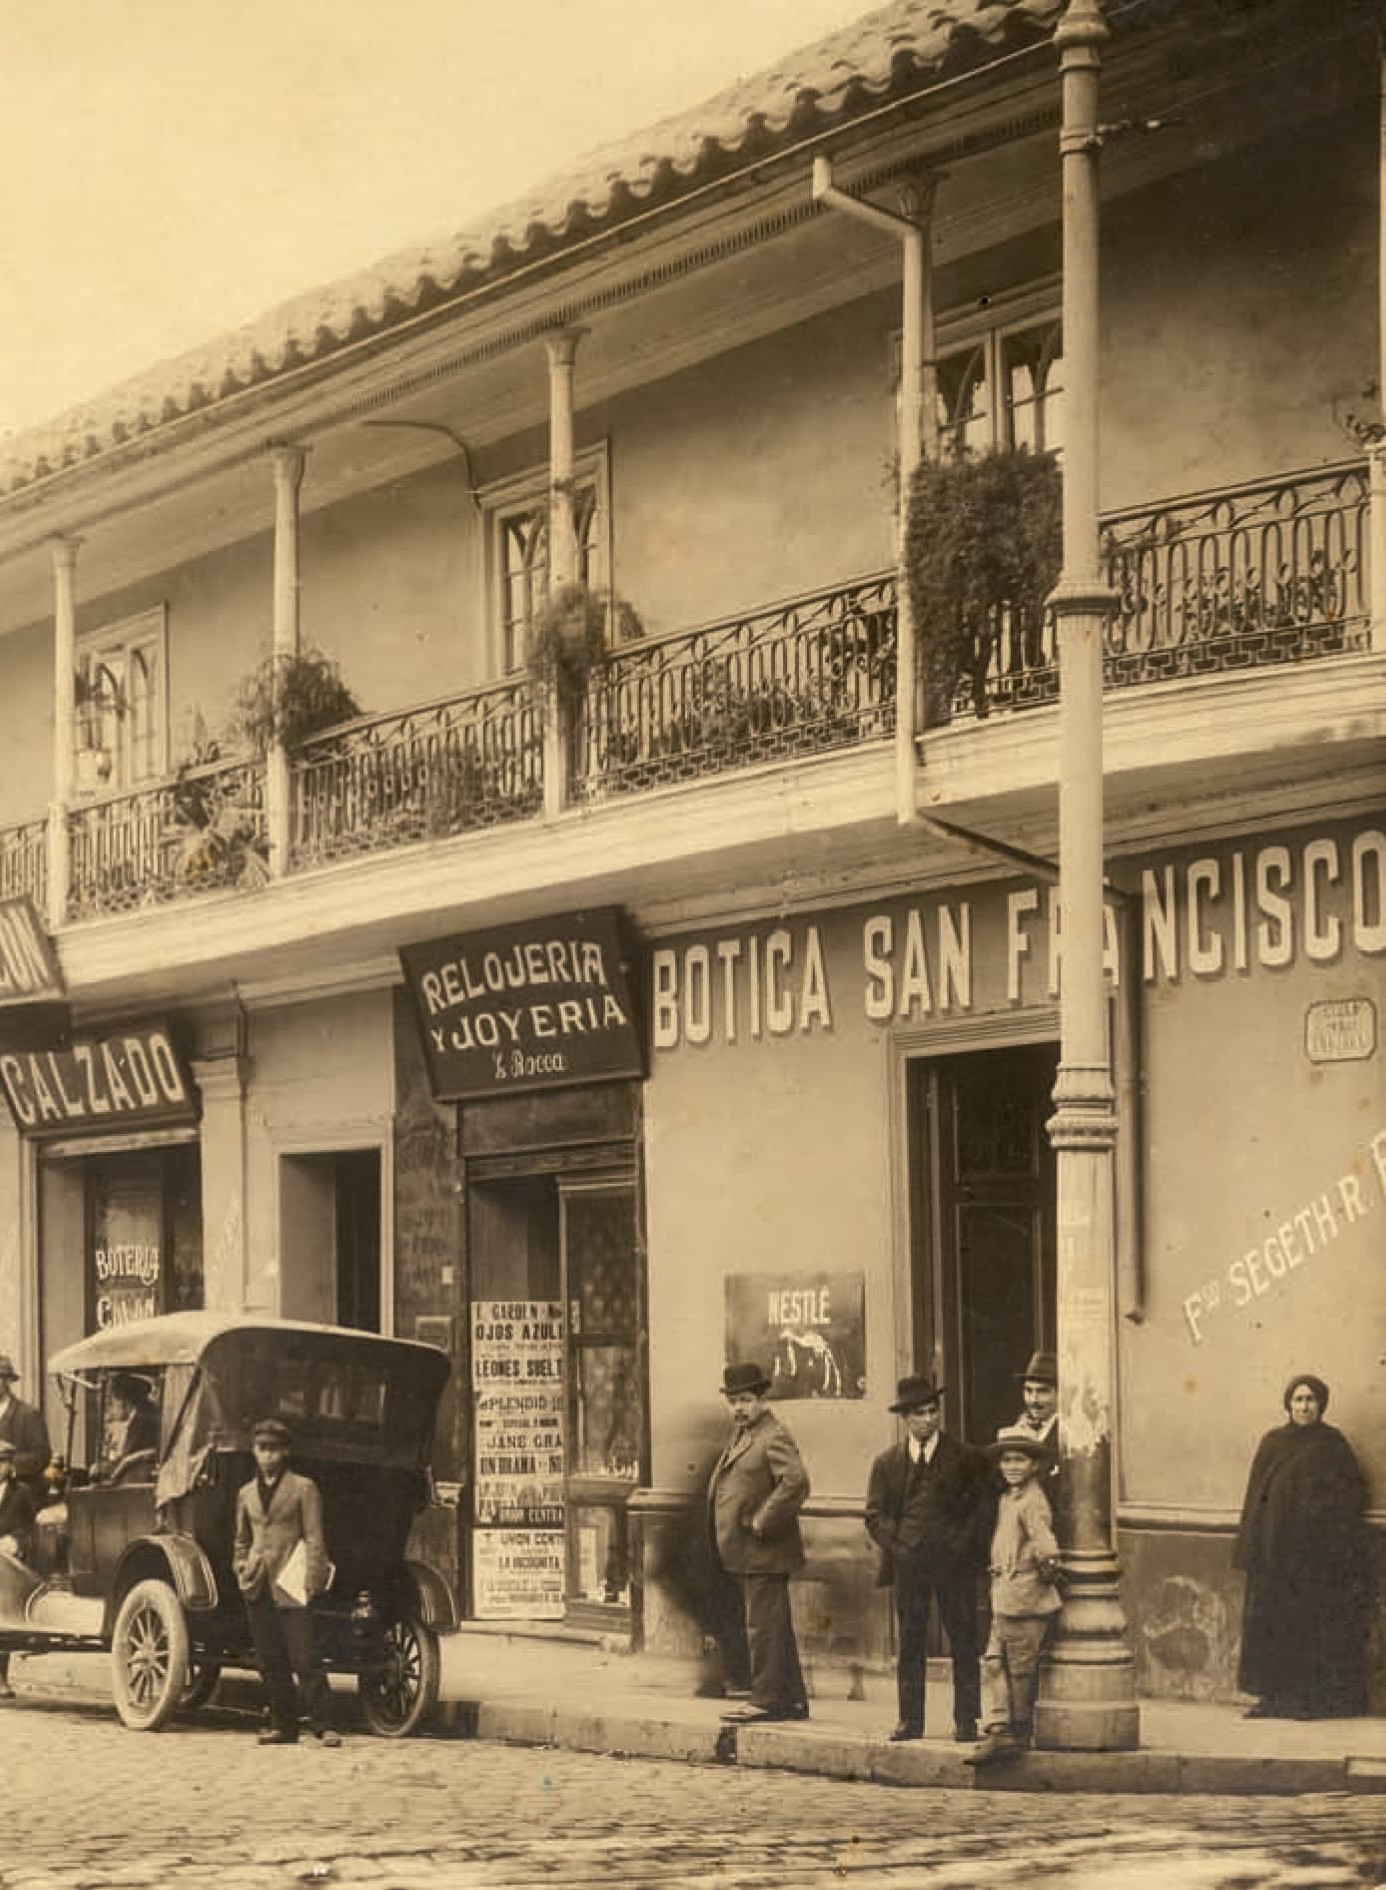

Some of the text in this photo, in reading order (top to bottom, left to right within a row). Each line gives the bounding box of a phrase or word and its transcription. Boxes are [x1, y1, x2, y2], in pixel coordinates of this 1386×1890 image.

[422, 941, 607, 1016] RELOJERIA
[653, 927, 833, 1048] BOTICA
[863, 902, 972, 1019] SAN
[431, 994, 628, 1052] Y JOYERIA
[0, 1033, 186, 1126] CALZADO
[1228, 1194, 1340, 1306] SEGETH
[476, 1323, 512, 1340] OJOS
